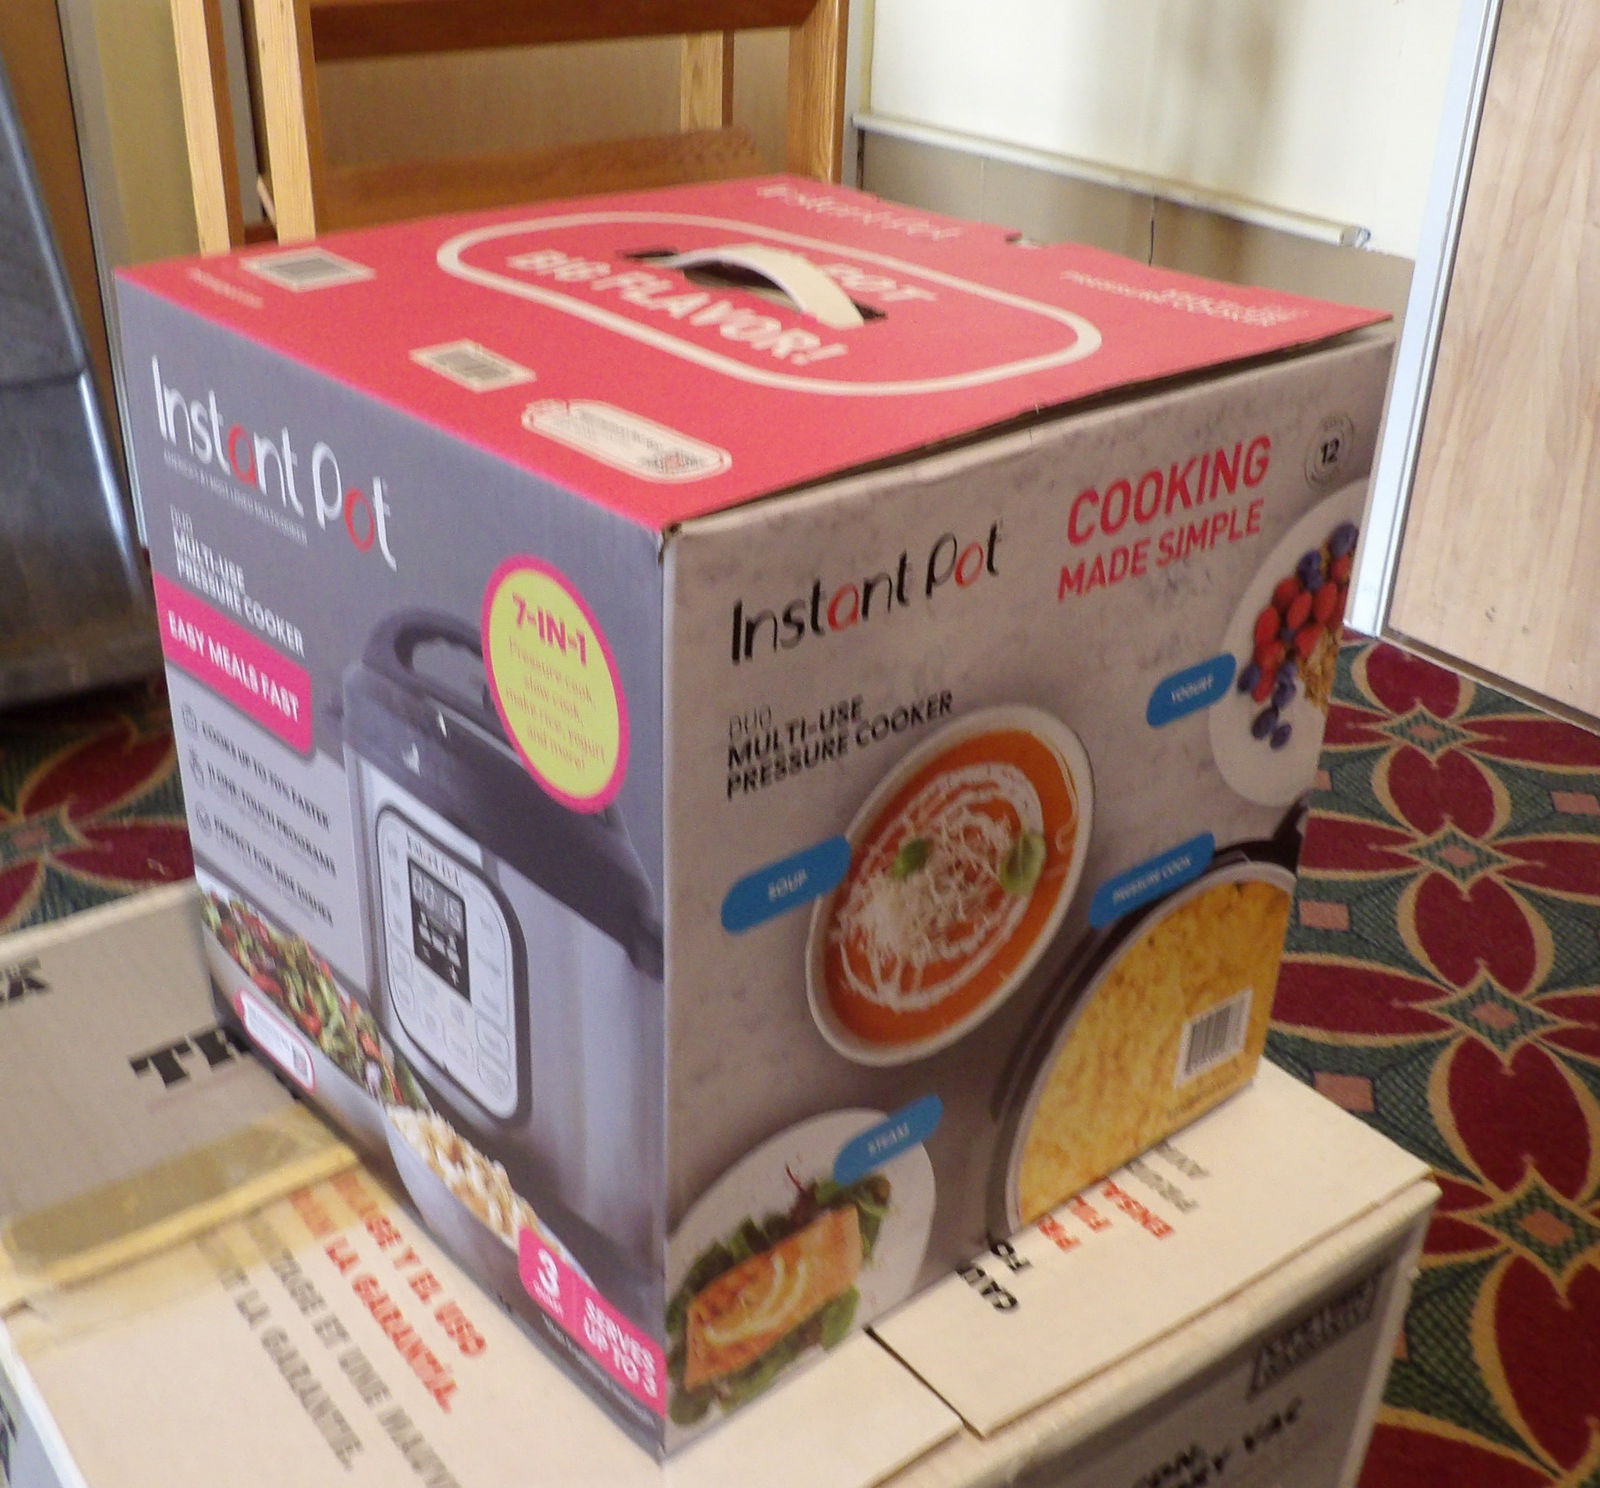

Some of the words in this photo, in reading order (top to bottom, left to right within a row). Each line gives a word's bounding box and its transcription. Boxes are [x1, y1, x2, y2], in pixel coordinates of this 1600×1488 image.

[506, 248, 611, 283] BIG
[592, 270, 850, 366] FLAVOR!
[151, 353, 306, 517] Instant
[311, 440, 398, 573] Pot
[1067, 435, 1273, 547] COOKING
[1320, 437, 1340, 465] 12
[173, 526, 246, 595] MULTI-USE
[732, 553, 909, 666] Instant
[925, 521, 1003, 598] Pot
[1057, 538, 1149, 602] MADE
[1157, 499, 1264, 567] SIMPLE
[176, 553, 243, 617] PRESSURE
[244, 595, 306, 659] COOKER
[512, 591, 589, 668] 7-IN-1
[168, 609, 205, 657] EASY
[208, 634, 260, 694] MEALS
[260, 671, 300, 724] FAST
[726, 733, 850, 801] PRESSURE
[855, 688, 954, 748] COOKER
[728, 693, 864, 770] MULTI-USE
[536, 1247, 561, 1299] 3
[582, 1313, 610, 1353] UP
[606, 1341, 640, 1385] TO
[640, 1370, 658, 1398] 3
[583, 1295, 657, 1377] SERVES
